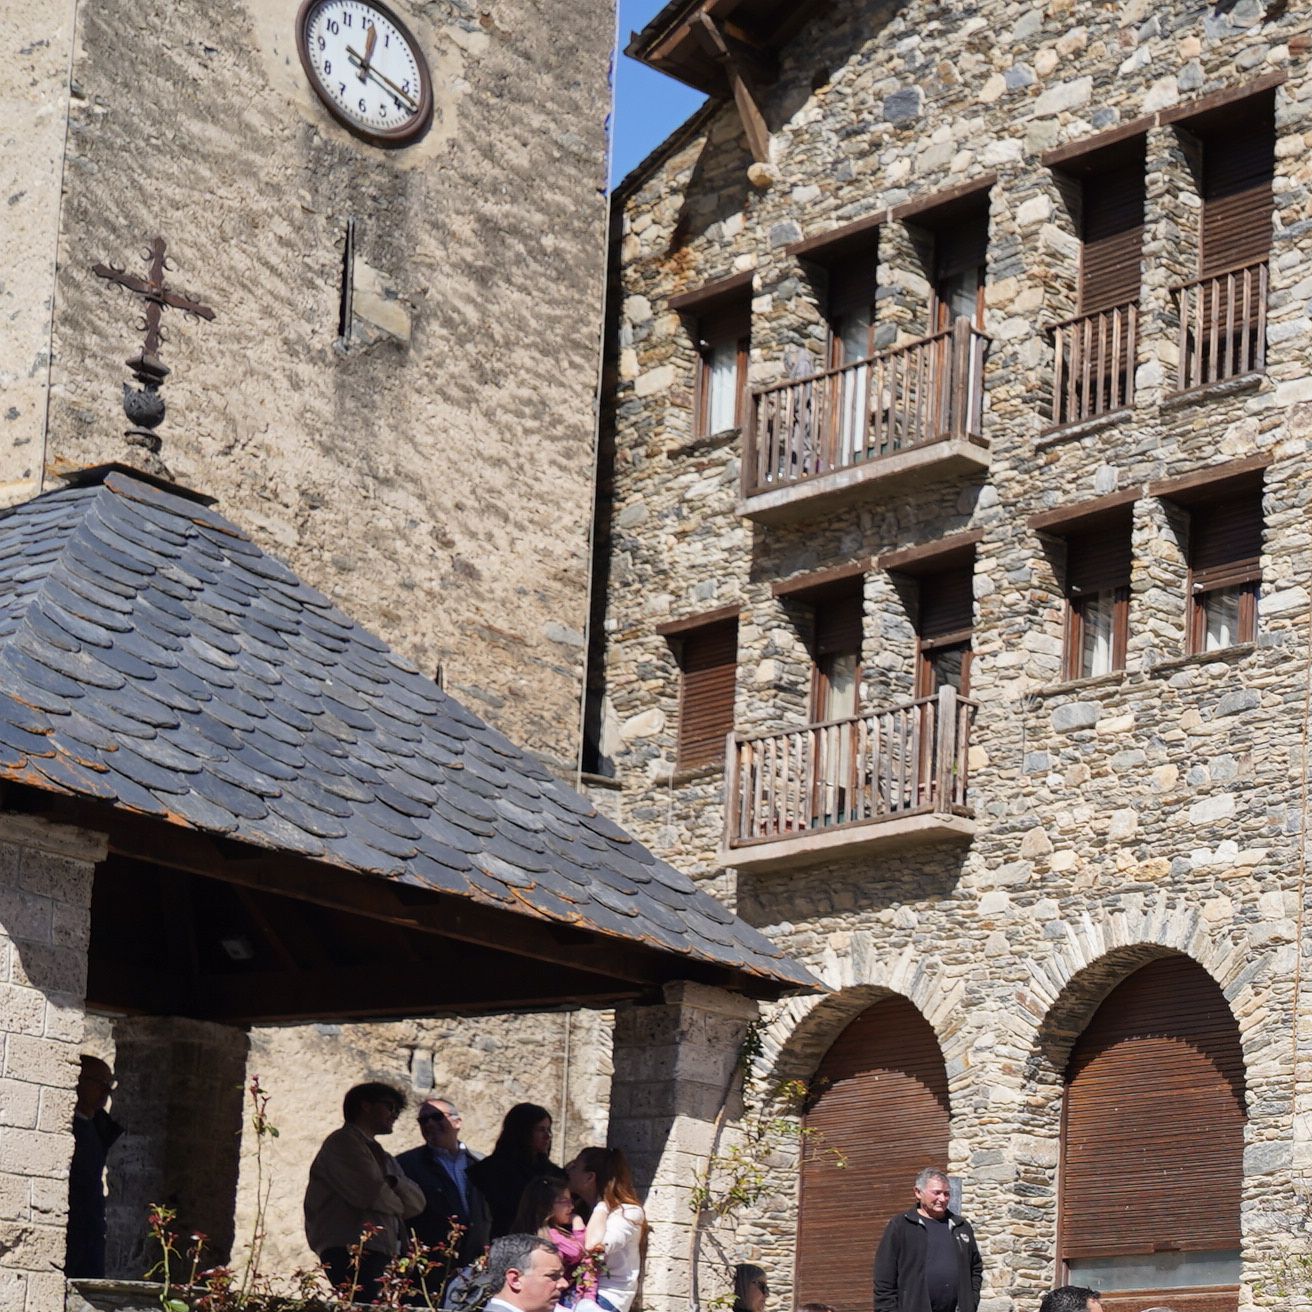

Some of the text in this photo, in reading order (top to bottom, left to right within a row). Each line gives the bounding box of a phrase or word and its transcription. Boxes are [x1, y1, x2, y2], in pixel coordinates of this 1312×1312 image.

[326, 18, 339, 35] 10
[343, 11, 352, 27] 11
[317, 36, 326, 51] 9
[385, 34, 390, 48] 1
[324, 60, 331, 75] 8
[339, 82, 346, 96] 7
[358, 98, 366, 113] 6
[379, 103, 387, 118] 5
